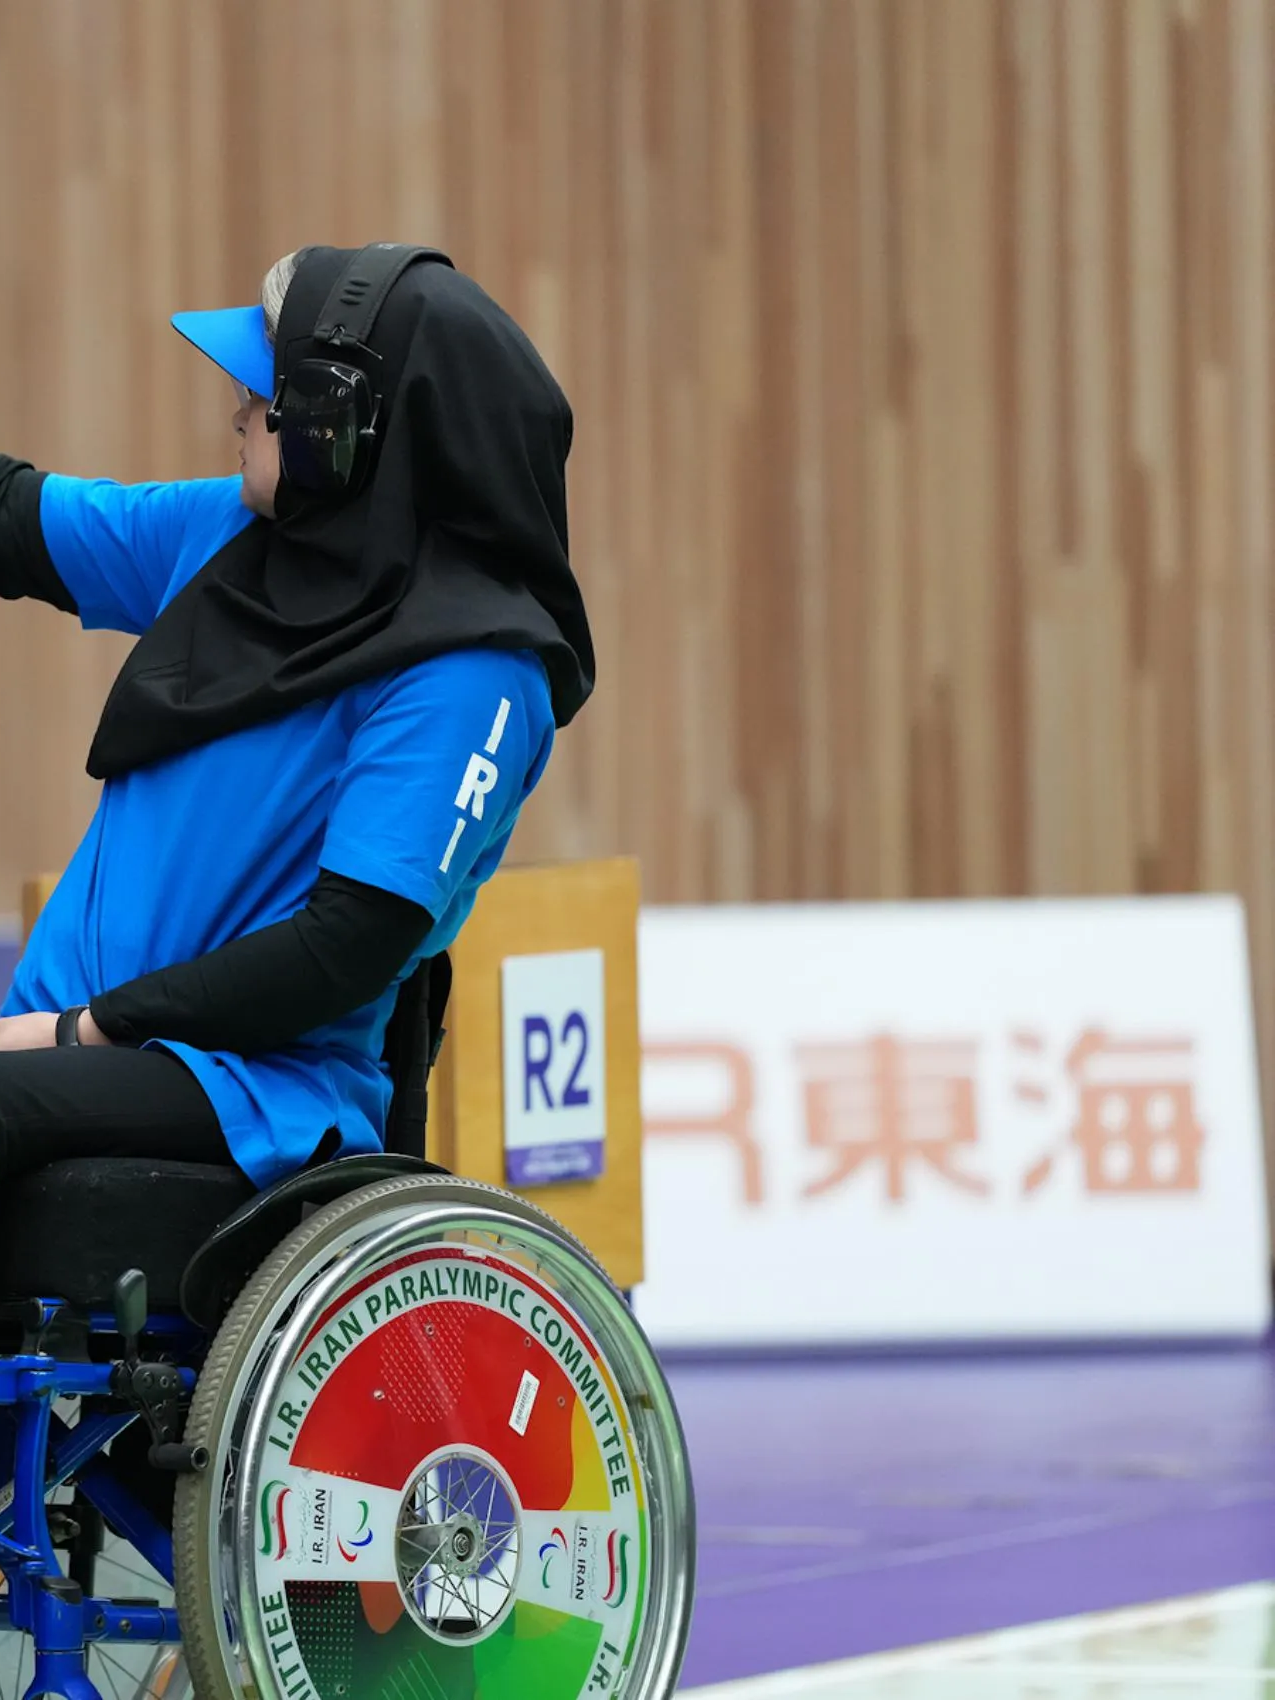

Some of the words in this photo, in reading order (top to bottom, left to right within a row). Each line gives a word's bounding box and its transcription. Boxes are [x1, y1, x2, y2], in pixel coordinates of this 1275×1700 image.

[439, 697, 511, 874] IRI
[524, 1010, 591, 1112] R2
[268, 1400, 308, 1452] I.R.
[297, 1311, 365, 1392] IRAN
[364, 1266, 526, 1325] PARALYMPIC
[529, 1305, 631, 1498] COMMITTEE
[313, 1488, 327, 1531] IRAN
[311, 1537, 325, 1564] I.R.
[577, 1526, 588, 1553] I.R.
[574, 1558, 586, 1601] IRAN
[587, 1641, 621, 1693] I.R.
